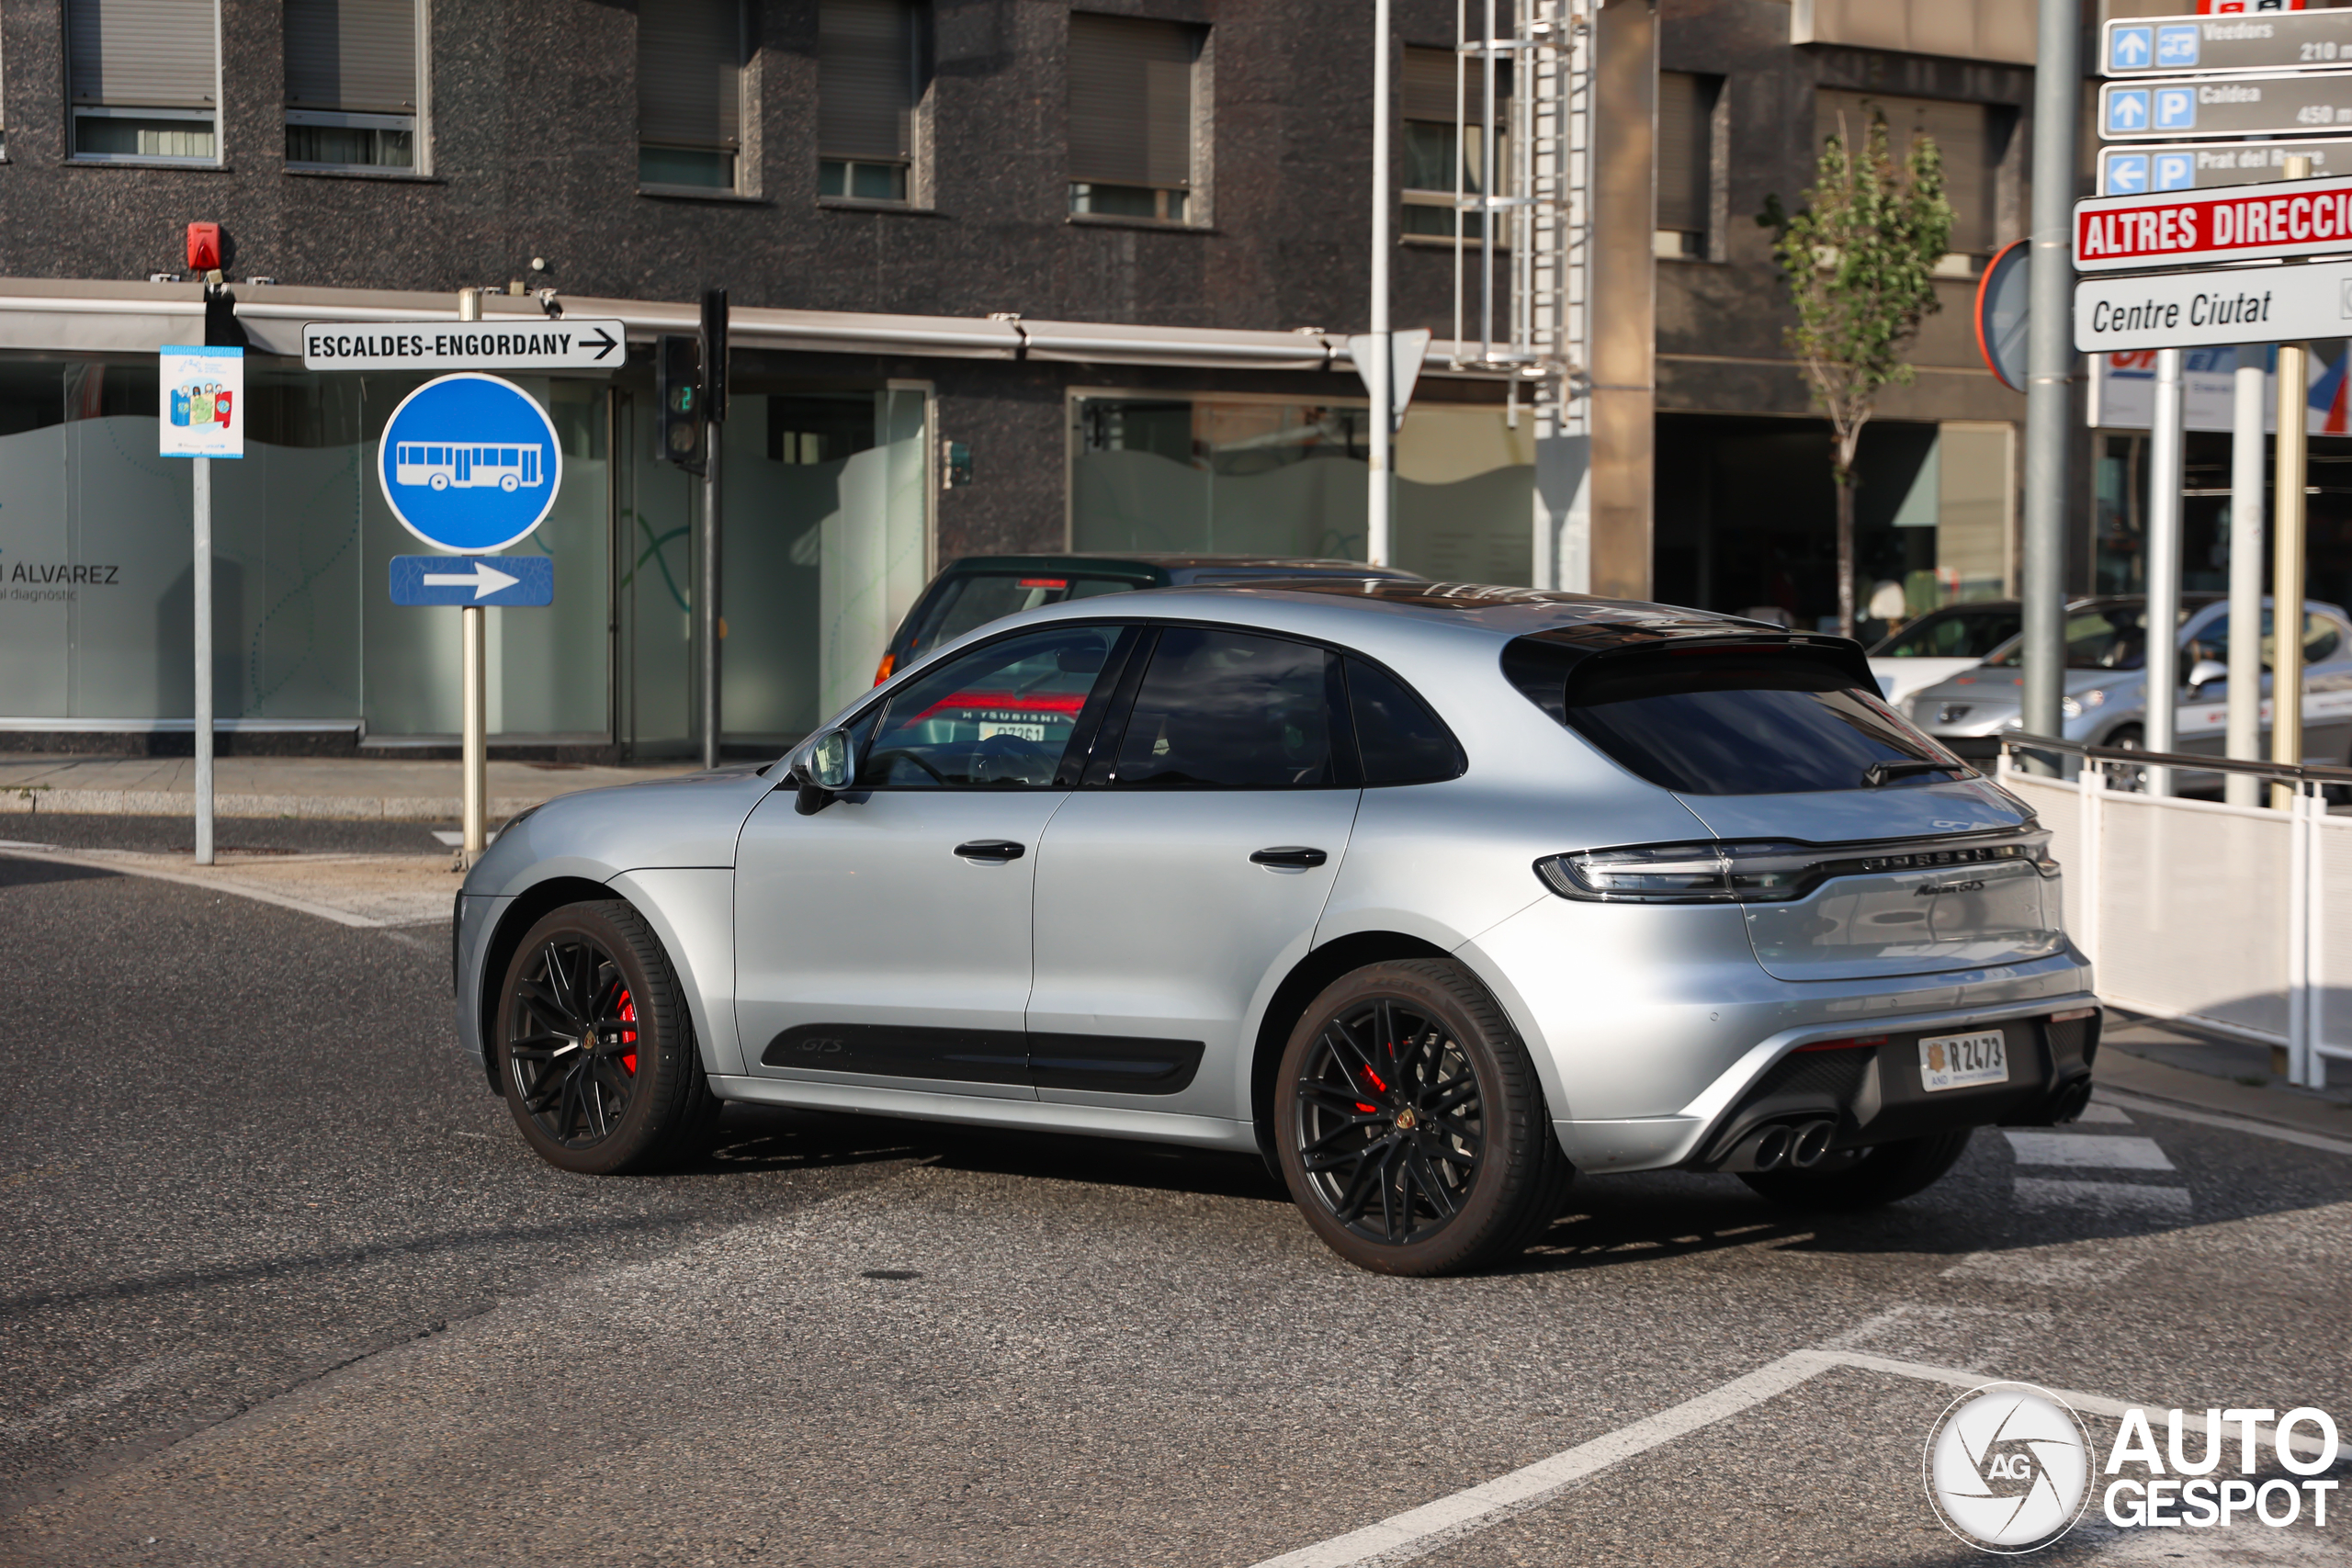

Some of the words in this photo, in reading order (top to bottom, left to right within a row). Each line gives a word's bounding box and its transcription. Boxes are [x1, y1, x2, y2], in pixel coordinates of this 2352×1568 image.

[2202, 22, 2275, 40] Veedors
[2300, 41, 2337, 61] 210
[2199, 85, 2262, 104] Caldea
[2296, 105, 2334, 124] 450
[2198, 151, 2235, 169] Prat
[2239, 149, 2267, 168] del
[2084, 207, 2199, 256] ALTRES
[2212, 194, 2352, 246] DIRECCI
[2094, 299, 2180, 333] Centre
[2190, 290, 2272, 327] Ciutat
[309, 333, 571, 357] ESCALDES-ENGORDANY
[682, 386, 692, 411] 2
[11, 559, 119, 585] ÁLVAREZ
[11, 588, 77, 603] diagnòstic
[1913, 883, 1957, 897] Macan
[1959, 879, 1985, 893] GTS
[801, 1037, 844, 1053] GTS
[1950, 1042, 1962, 1073] R
[1962, 1036, 2004, 1071] 2473
[1931, 1075, 1949, 1087] AND
